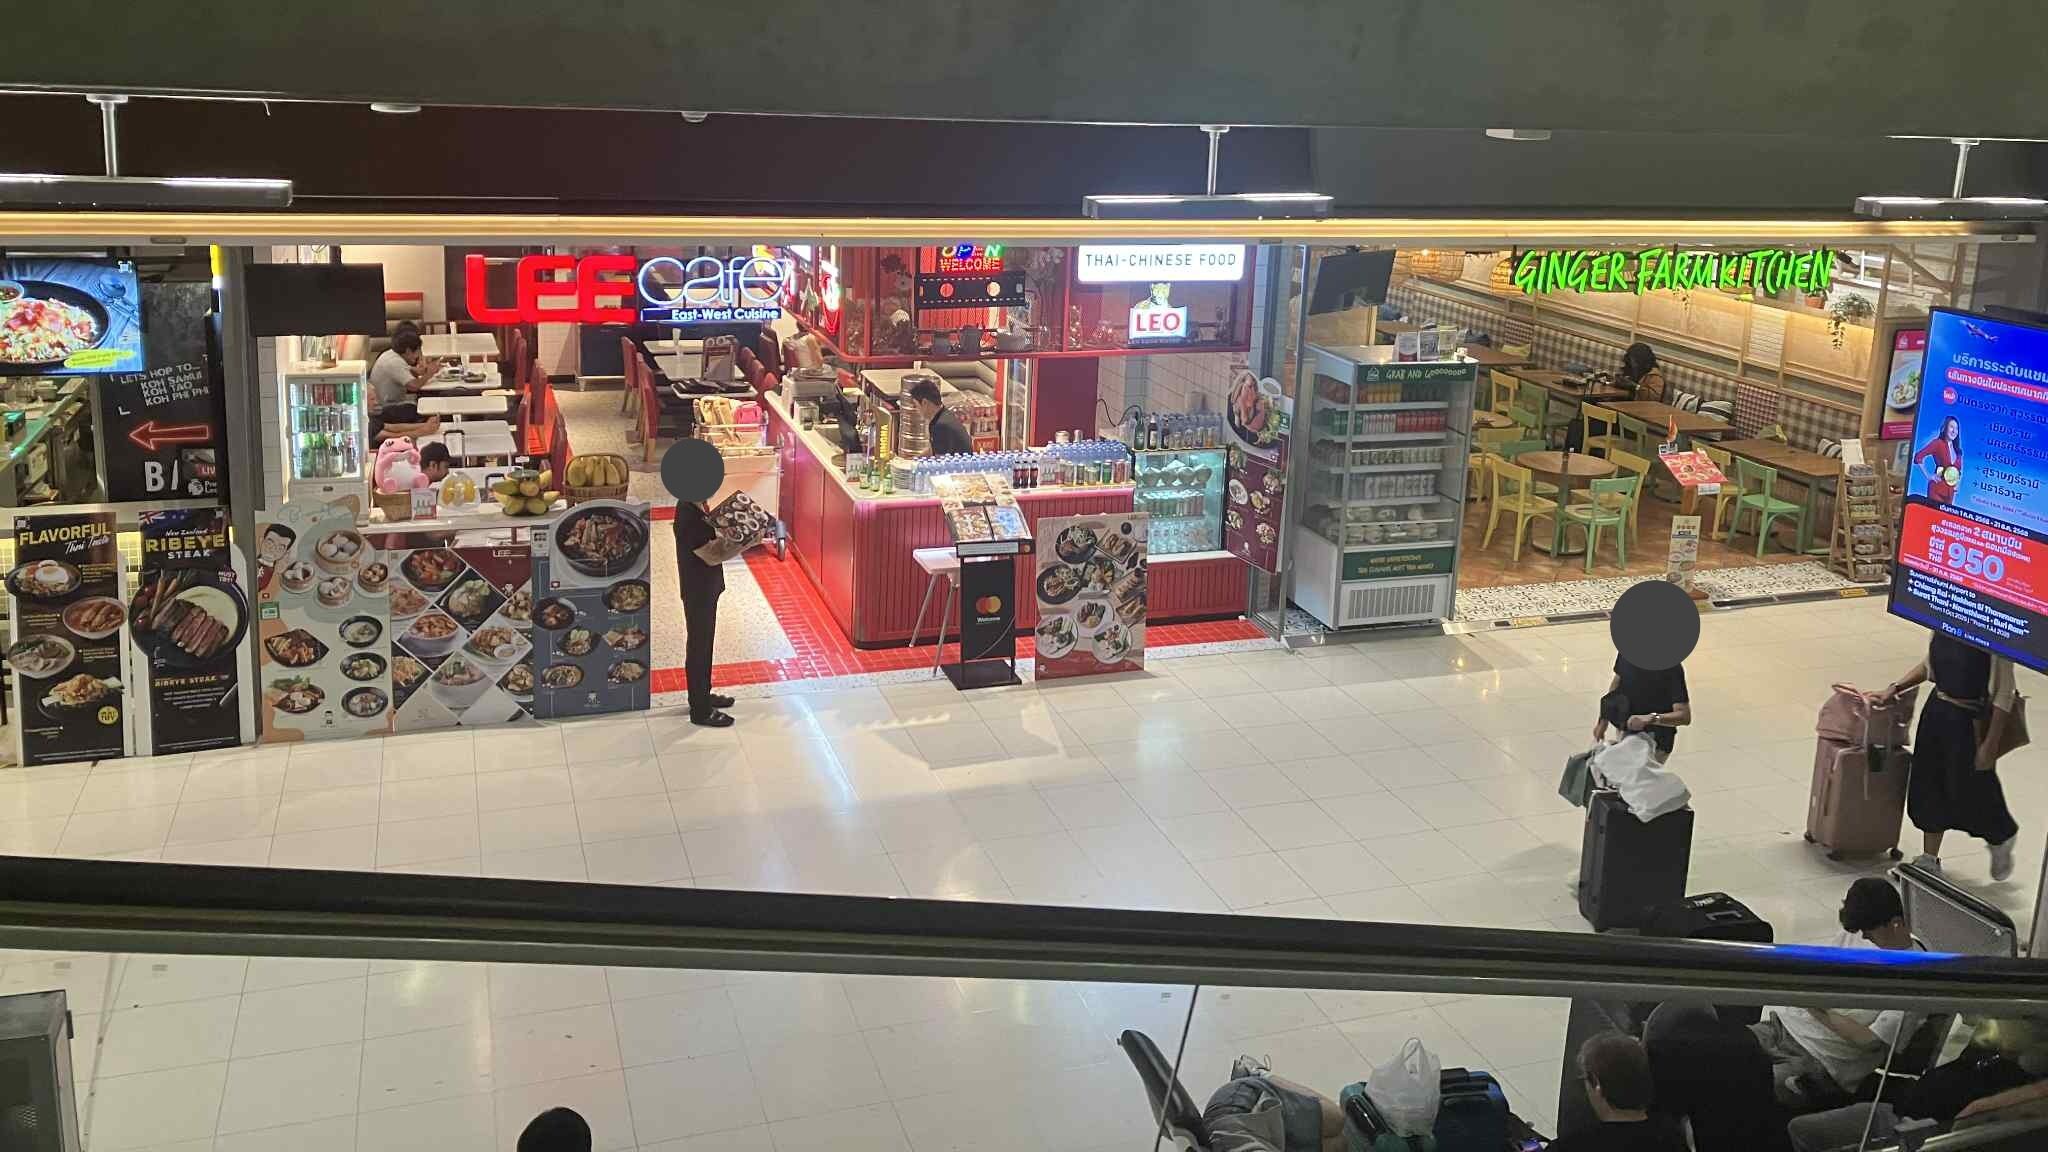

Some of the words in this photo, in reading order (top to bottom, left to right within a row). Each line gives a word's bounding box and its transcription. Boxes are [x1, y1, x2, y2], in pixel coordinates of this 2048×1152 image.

[940, 258, 1001, 271] WELCOME
[1085, 253, 1193, 267] THAI-CHINESE
[1199, 253, 1236, 266] FOOD
[1514, 250, 1627, 294] GINGER
[1637, 248, 1715, 296] FARM
[1719, 249, 1835, 294] KITCHEN
[466, 253, 638, 325] LEE
[672, 308, 732, 321] East-West
[734, 308, 779, 320] Cuisine
[1136, 312, 1181, 332] LEO
[150, 366, 173, 379] HOP
[1386, 368, 1406, 380] GRAB
[1408, 368, 1422, 380] AND
[141, 379, 165, 390] KOH
[142, 387, 167, 398] KOH
[169, 381, 193, 393] TAO
[145, 395, 170, 406] KOH
[19, 522, 111, 546] FLAVORFUL
[1974, 526, 1981, 537] 2
[145, 533, 225, 552] RIBEYE
[167, 549, 211, 560] STEAK
[1948, 542, 2005, 582] 950
[1914, 580, 1936, 594] Chiang
[1949, 583, 1968, 597] Airport
